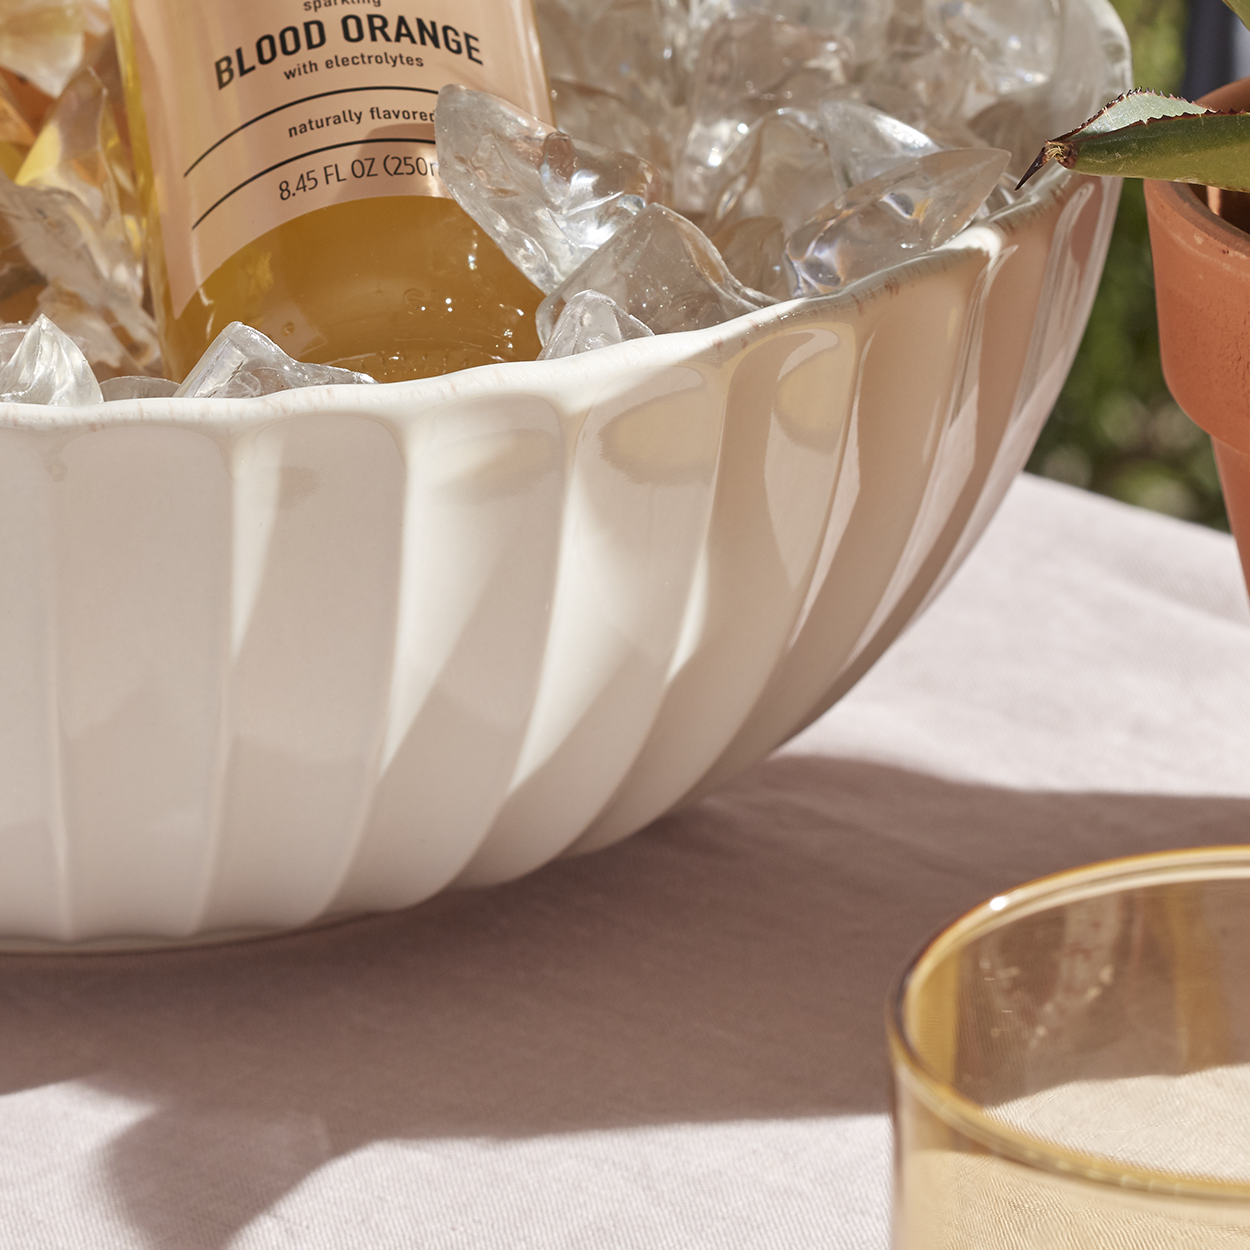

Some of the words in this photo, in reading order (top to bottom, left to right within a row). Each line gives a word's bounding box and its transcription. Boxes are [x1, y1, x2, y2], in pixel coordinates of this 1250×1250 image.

[214, 19, 327, 91] BLOOD
[340, 13, 484, 66] ORANGE
[283, 58, 319, 80] with
[324, 51, 425, 70] electrolytes
[287, 108, 363, 138] naturally
[278, 169, 319, 201] 8.45
[323, 163, 347, 185] FL
[350, 157, 379, 180] OZ
[382, 154, 440, 179] (250
